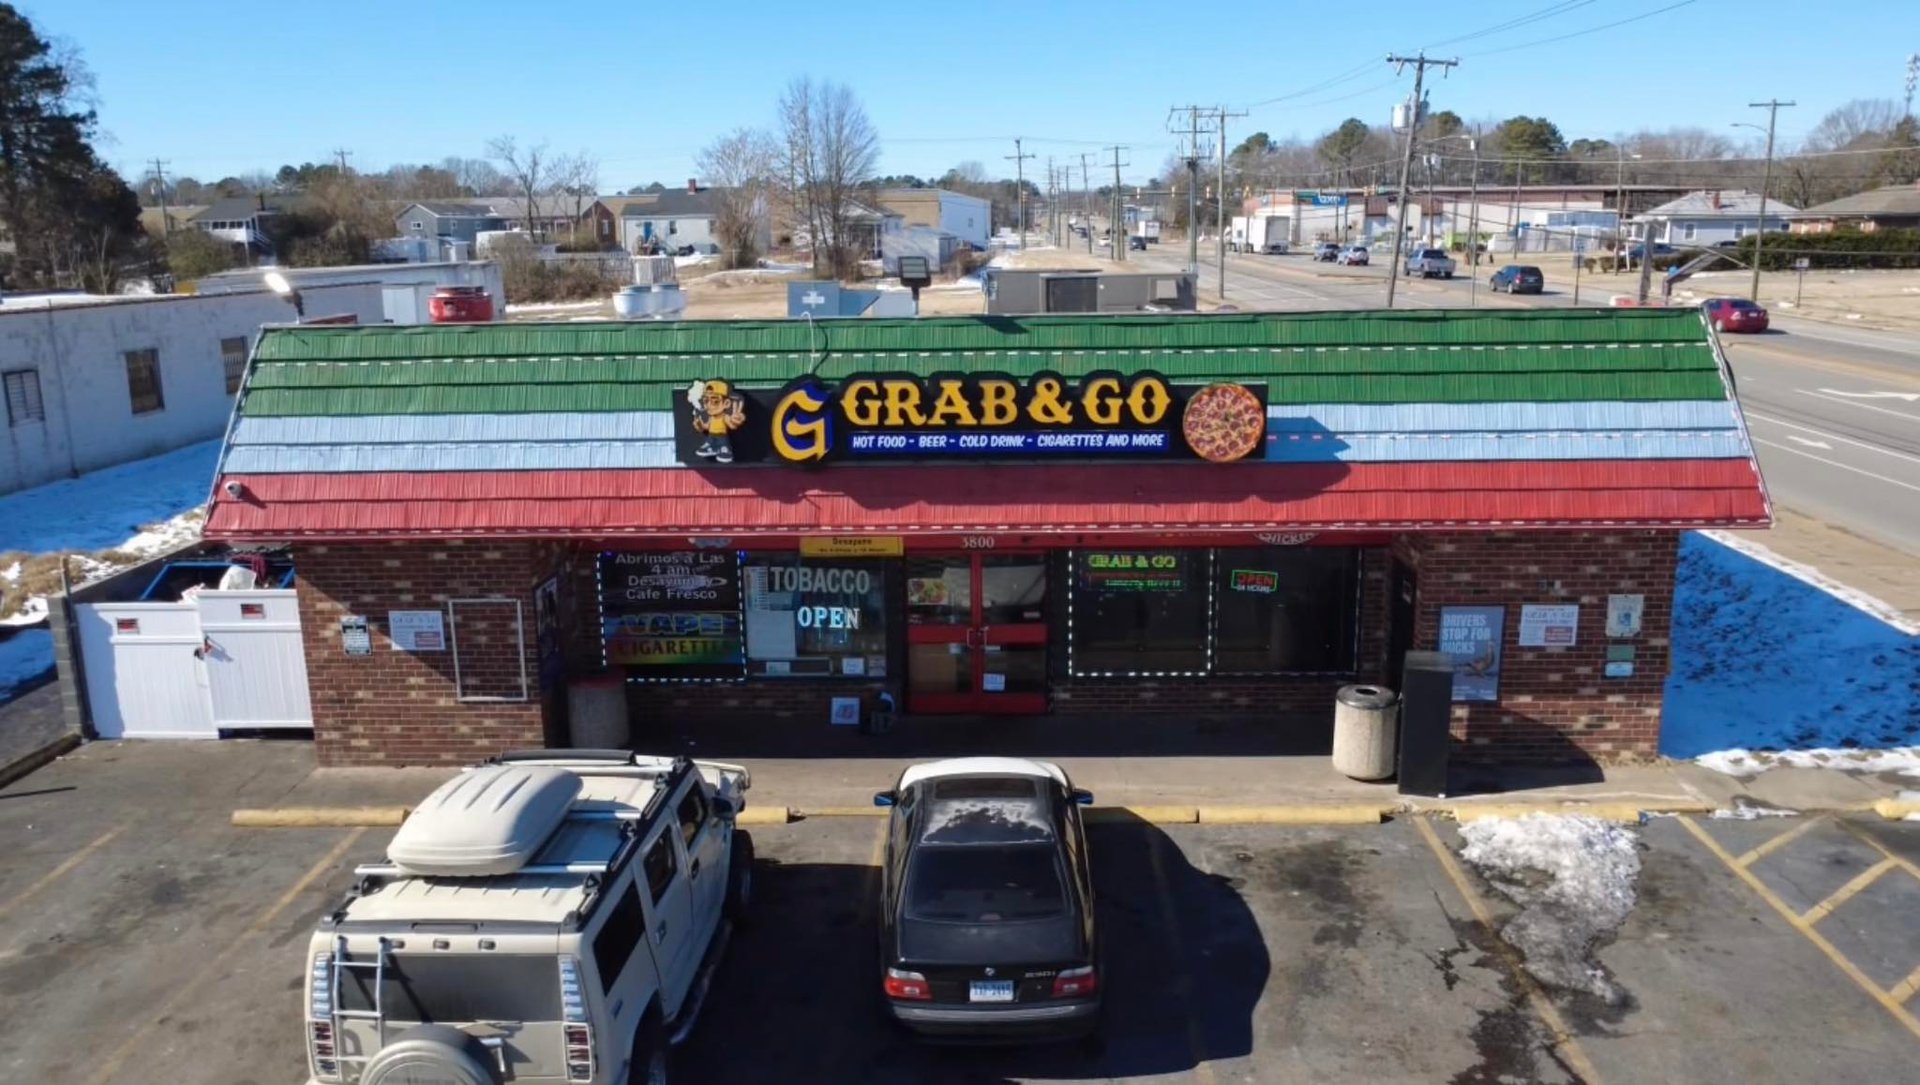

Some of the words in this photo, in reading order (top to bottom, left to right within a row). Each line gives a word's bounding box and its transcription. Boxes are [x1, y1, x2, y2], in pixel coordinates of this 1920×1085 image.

[840, 378, 1018, 427] GRAB
[1026, 377, 1074, 425] &
[1081, 376, 1171, 425] GO
[772, 384, 832, 461] G
[853, 435, 875, 448] HOT
[877, 435, 906, 448] FOOD
[918, 435, 947, 447] BEER
[959, 435, 988, 447] COLD
[990, 434, 1025, 447] DRINK
[1037, 434, 1102, 447] CIGARETTES
[1105, 434, 1129, 447] AND
[1131, 434, 1165, 446] MORE
[961, 535, 995, 549] 3800
[615, 552, 679, 564] Abrimos
[699, 552, 725, 564] Las
[1087, 554, 1132, 568] GRAB
[1135, 554, 1149, 568] &
[1151, 555, 1176, 569] GO
[651, 564, 660, 574] 4
[667, 565, 690, 575] am
[770, 566, 870, 595] TOBACCO
[626, 588, 661, 600] Cafe
[666, 588, 717, 600] Fresco
[621, 612, 724, 636] VAPE
[797, 606, 861, 629] OPEN
[1443, 614, 1487, 626] DRIVERS
[1441, 627, 1468, 640] STOP
[1470, 627, 1491, 640] FOR
